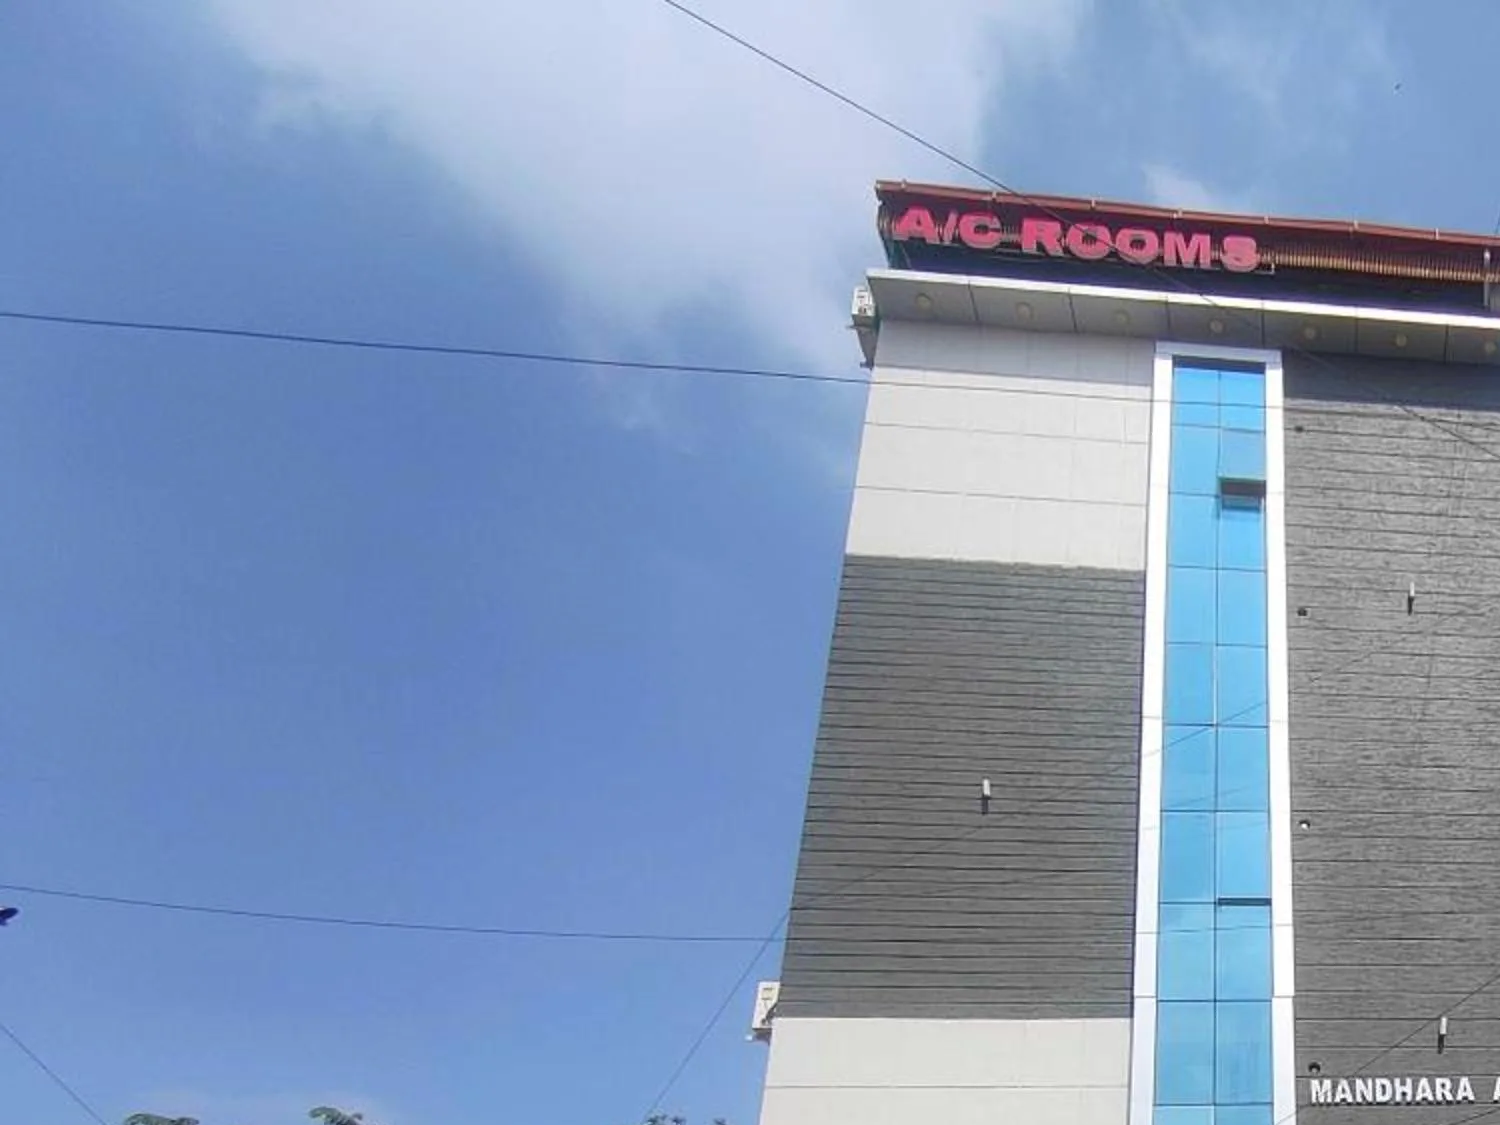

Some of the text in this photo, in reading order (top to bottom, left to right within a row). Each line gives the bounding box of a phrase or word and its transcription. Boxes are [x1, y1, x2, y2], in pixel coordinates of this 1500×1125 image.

[893, 206, 1262, 273] A/C ROOMS
[1310, 1076, 1475, 1105] MANDHARA
